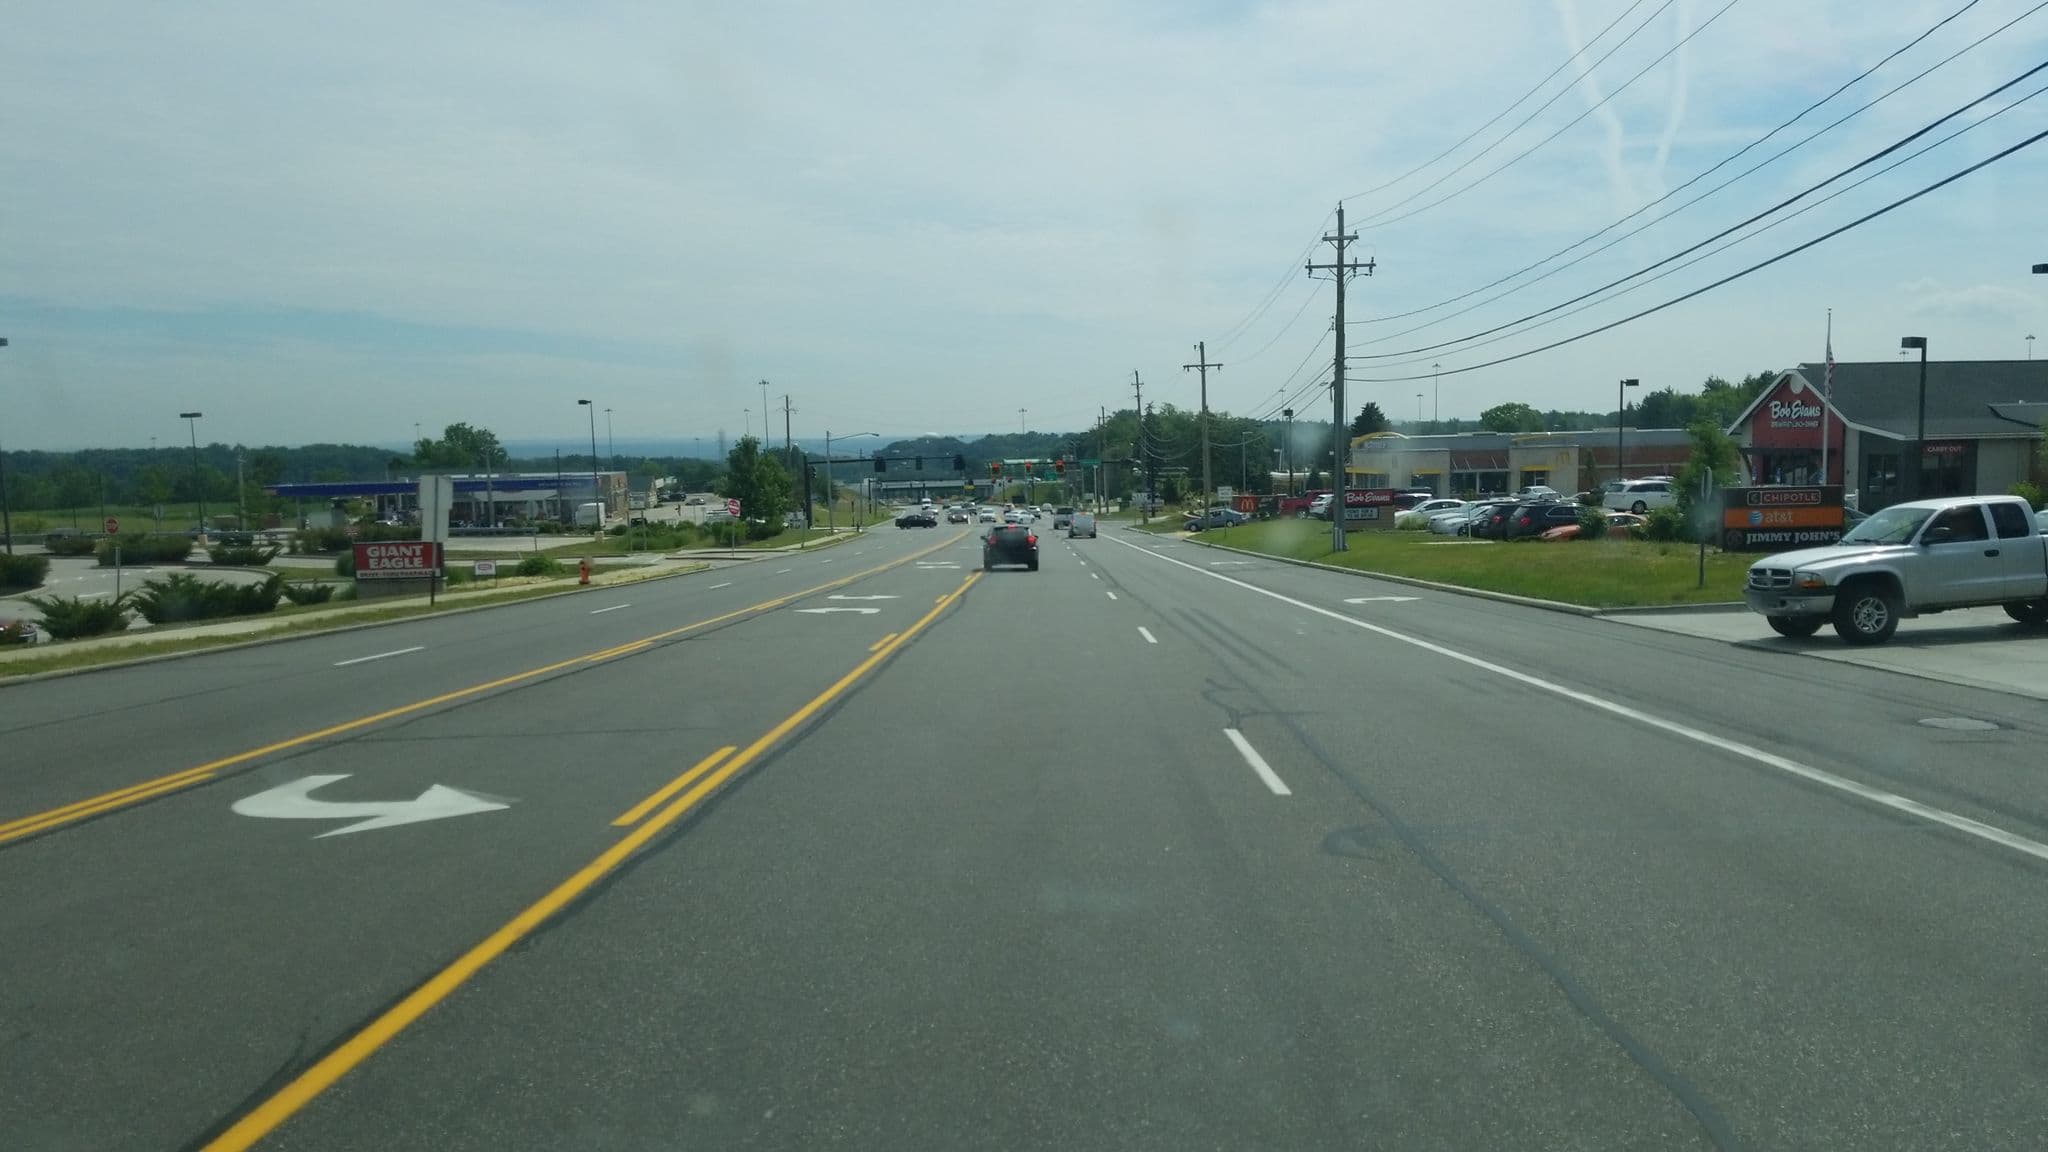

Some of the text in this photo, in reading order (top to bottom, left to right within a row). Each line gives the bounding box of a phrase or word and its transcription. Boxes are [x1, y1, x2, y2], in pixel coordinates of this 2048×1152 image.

[1769, 400, 1821, 419] Bob Evans
[1344, 492, 1364, 503] Bob
[1763, 492, 1819, 502] CHIPOTLE
[1746, 530, 1841, 545] JIMMY JOHN'S
[366, 545, 424, 558] GIANT
[369, 557, 424, 569] EAGLE
